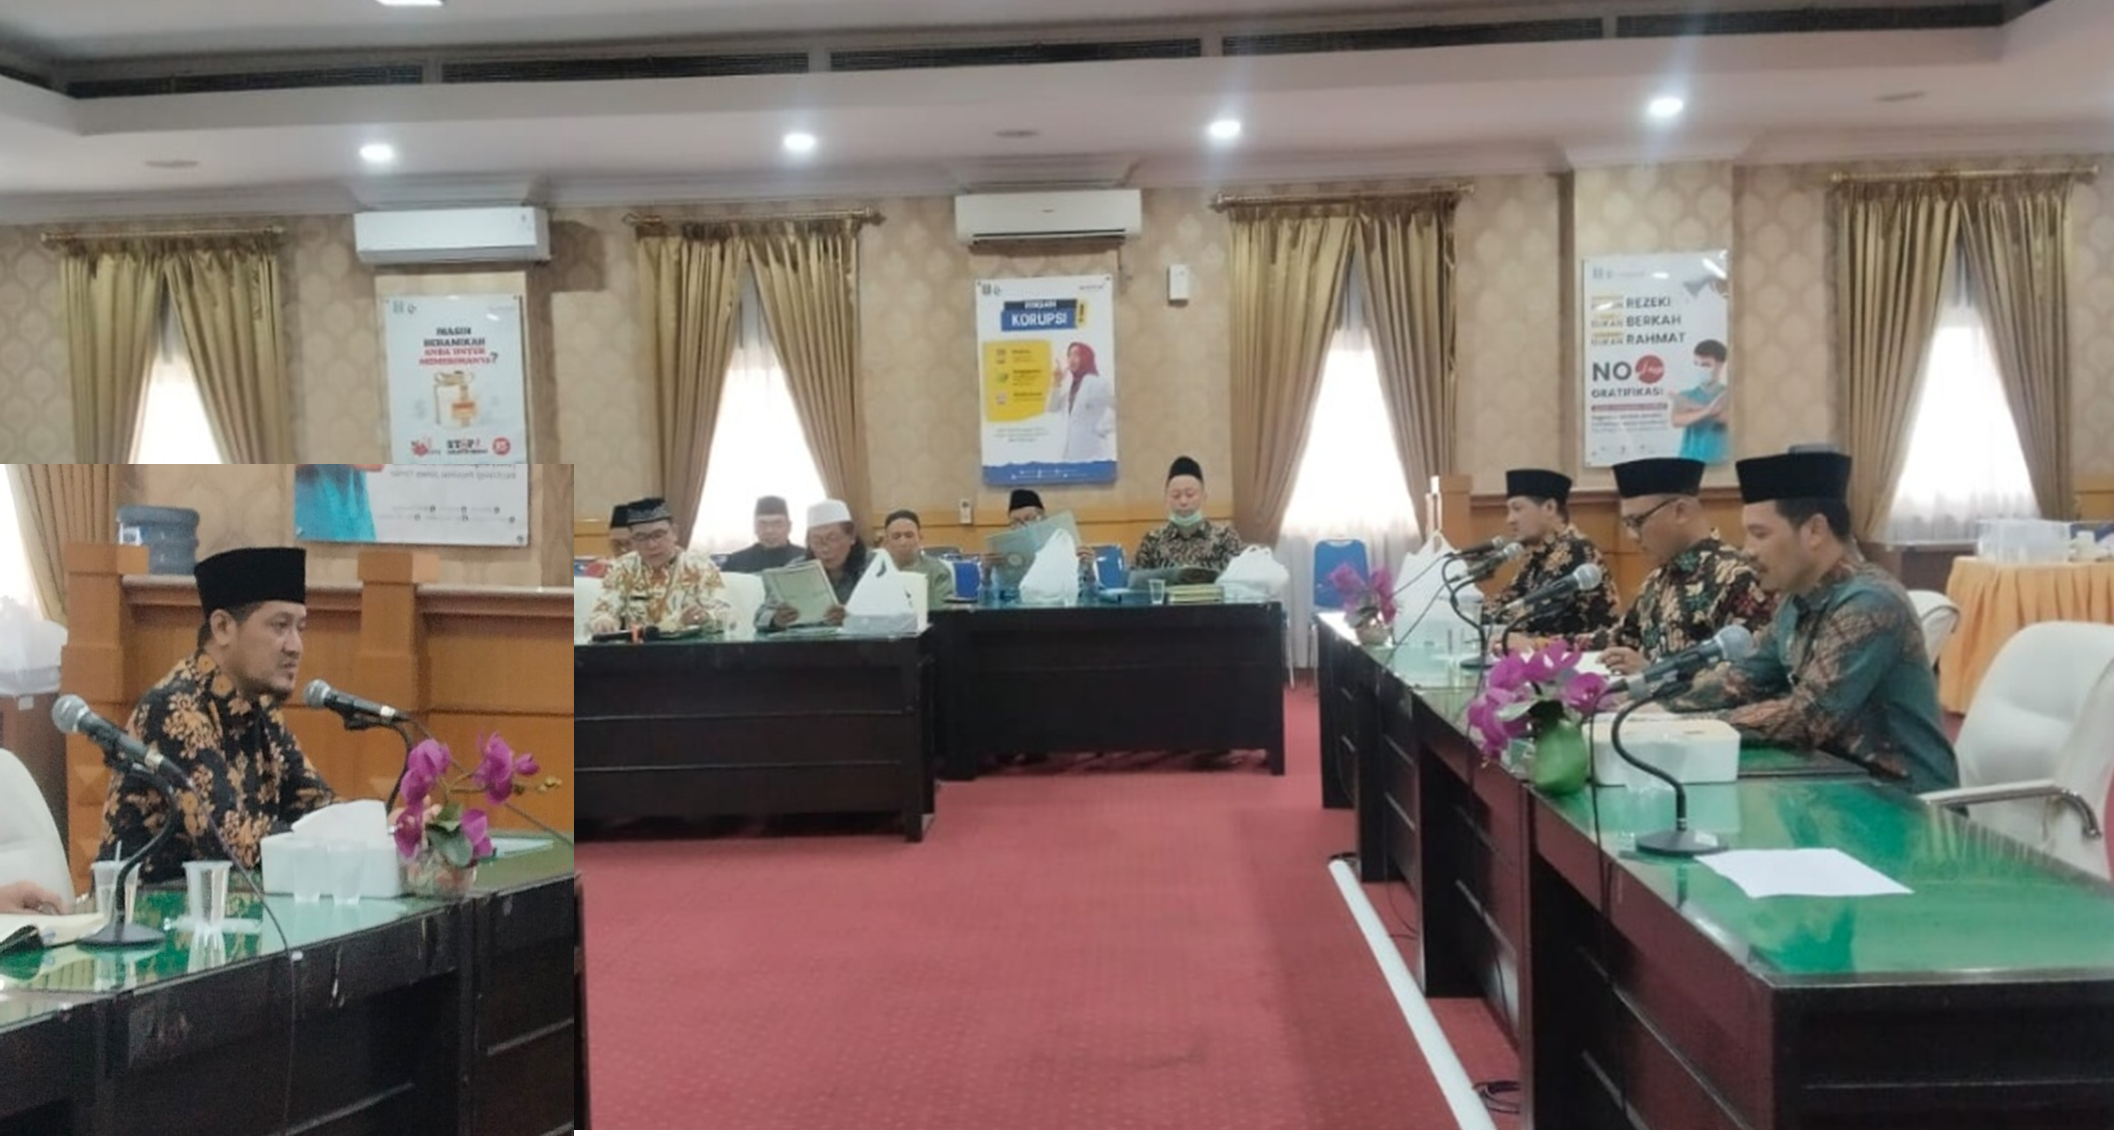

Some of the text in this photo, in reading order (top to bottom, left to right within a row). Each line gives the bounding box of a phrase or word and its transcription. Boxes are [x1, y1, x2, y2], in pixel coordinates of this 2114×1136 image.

[1626, 296, 1671, 309] REZEKI
[1011, 311, 1068, 327] KORUPSI
[1626, 314, 1682, 328] BERKAH
[1626, 332, 1686, 345] RAHMAT
[1592, 361, 1632, 382] NO
[1591, 386, 1664, 399] GRATIFIKASI
